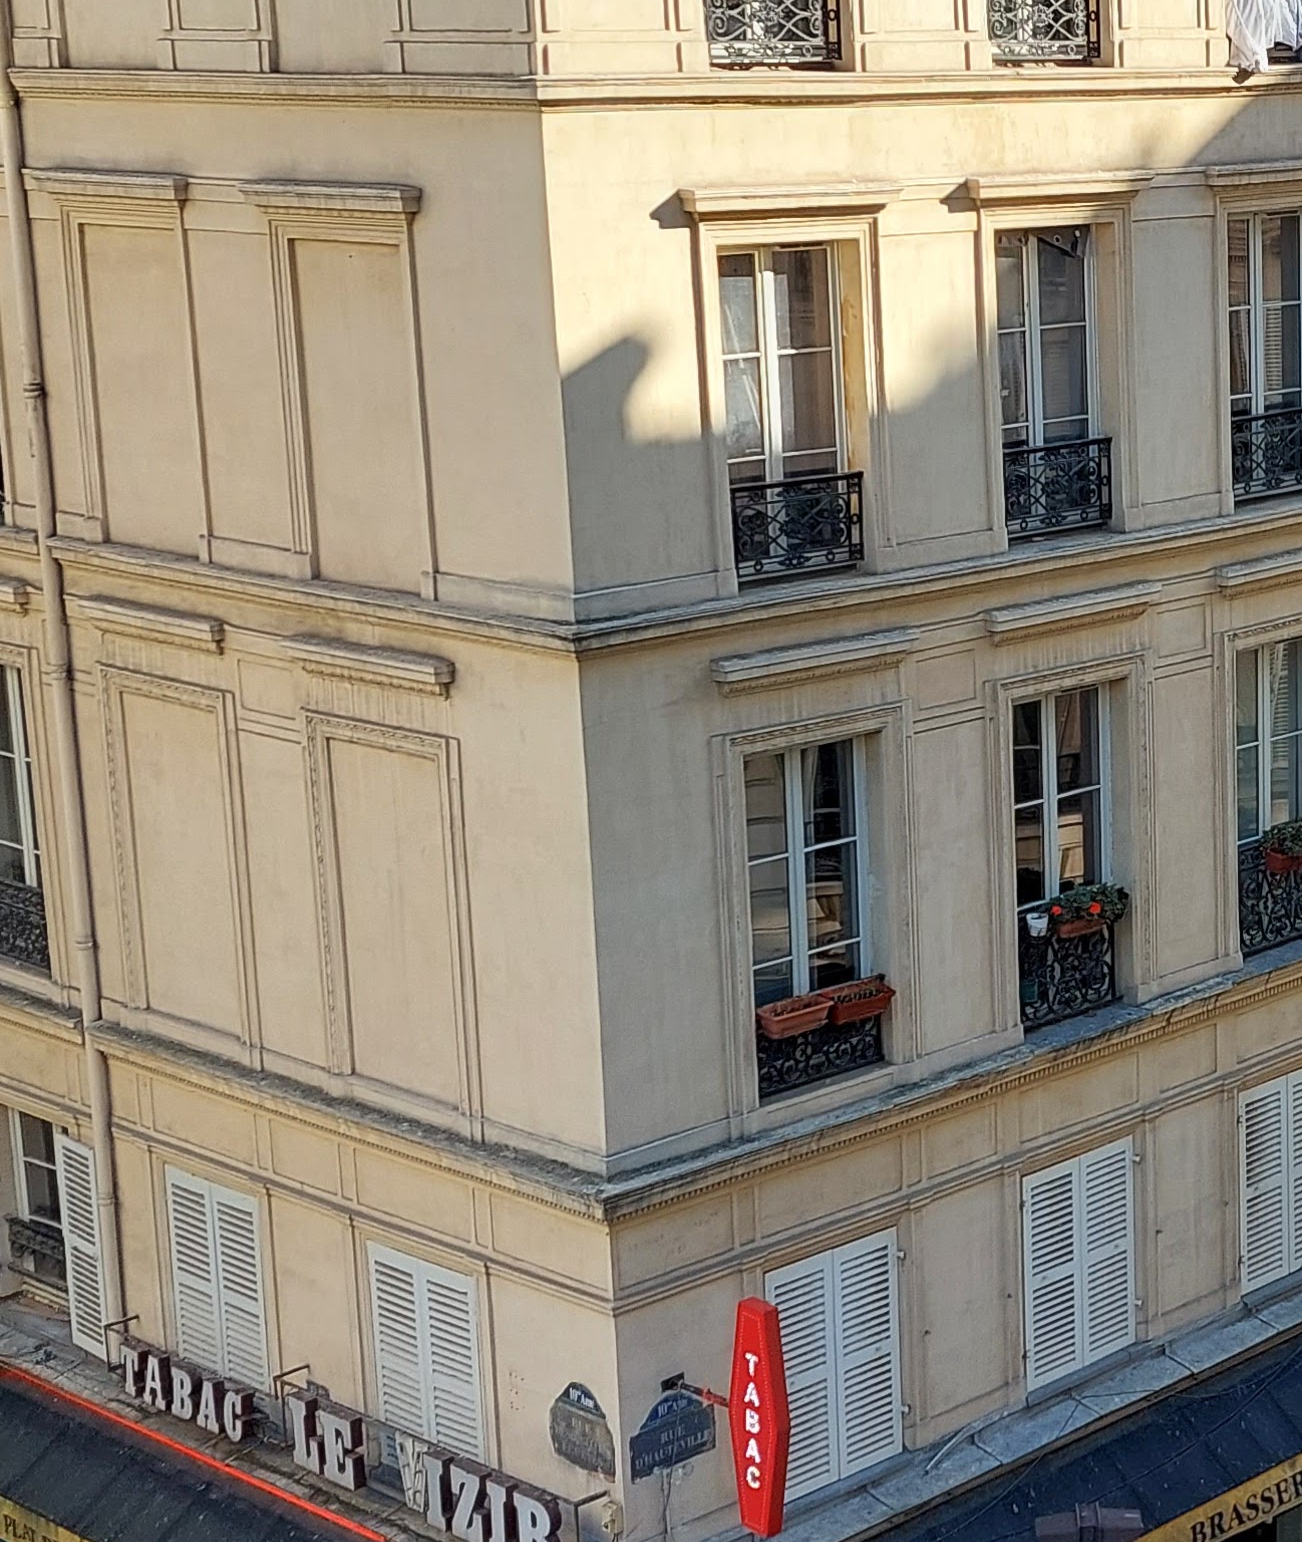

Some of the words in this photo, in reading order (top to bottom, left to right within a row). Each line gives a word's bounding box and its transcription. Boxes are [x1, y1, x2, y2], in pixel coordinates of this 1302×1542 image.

[120, 1344, 243, 1443] TABAC
[286, 1395, 355, 1492] LE
[661, 1424, 685, 1444] RUE
[744, 1352, 761, 1490] TABAC
